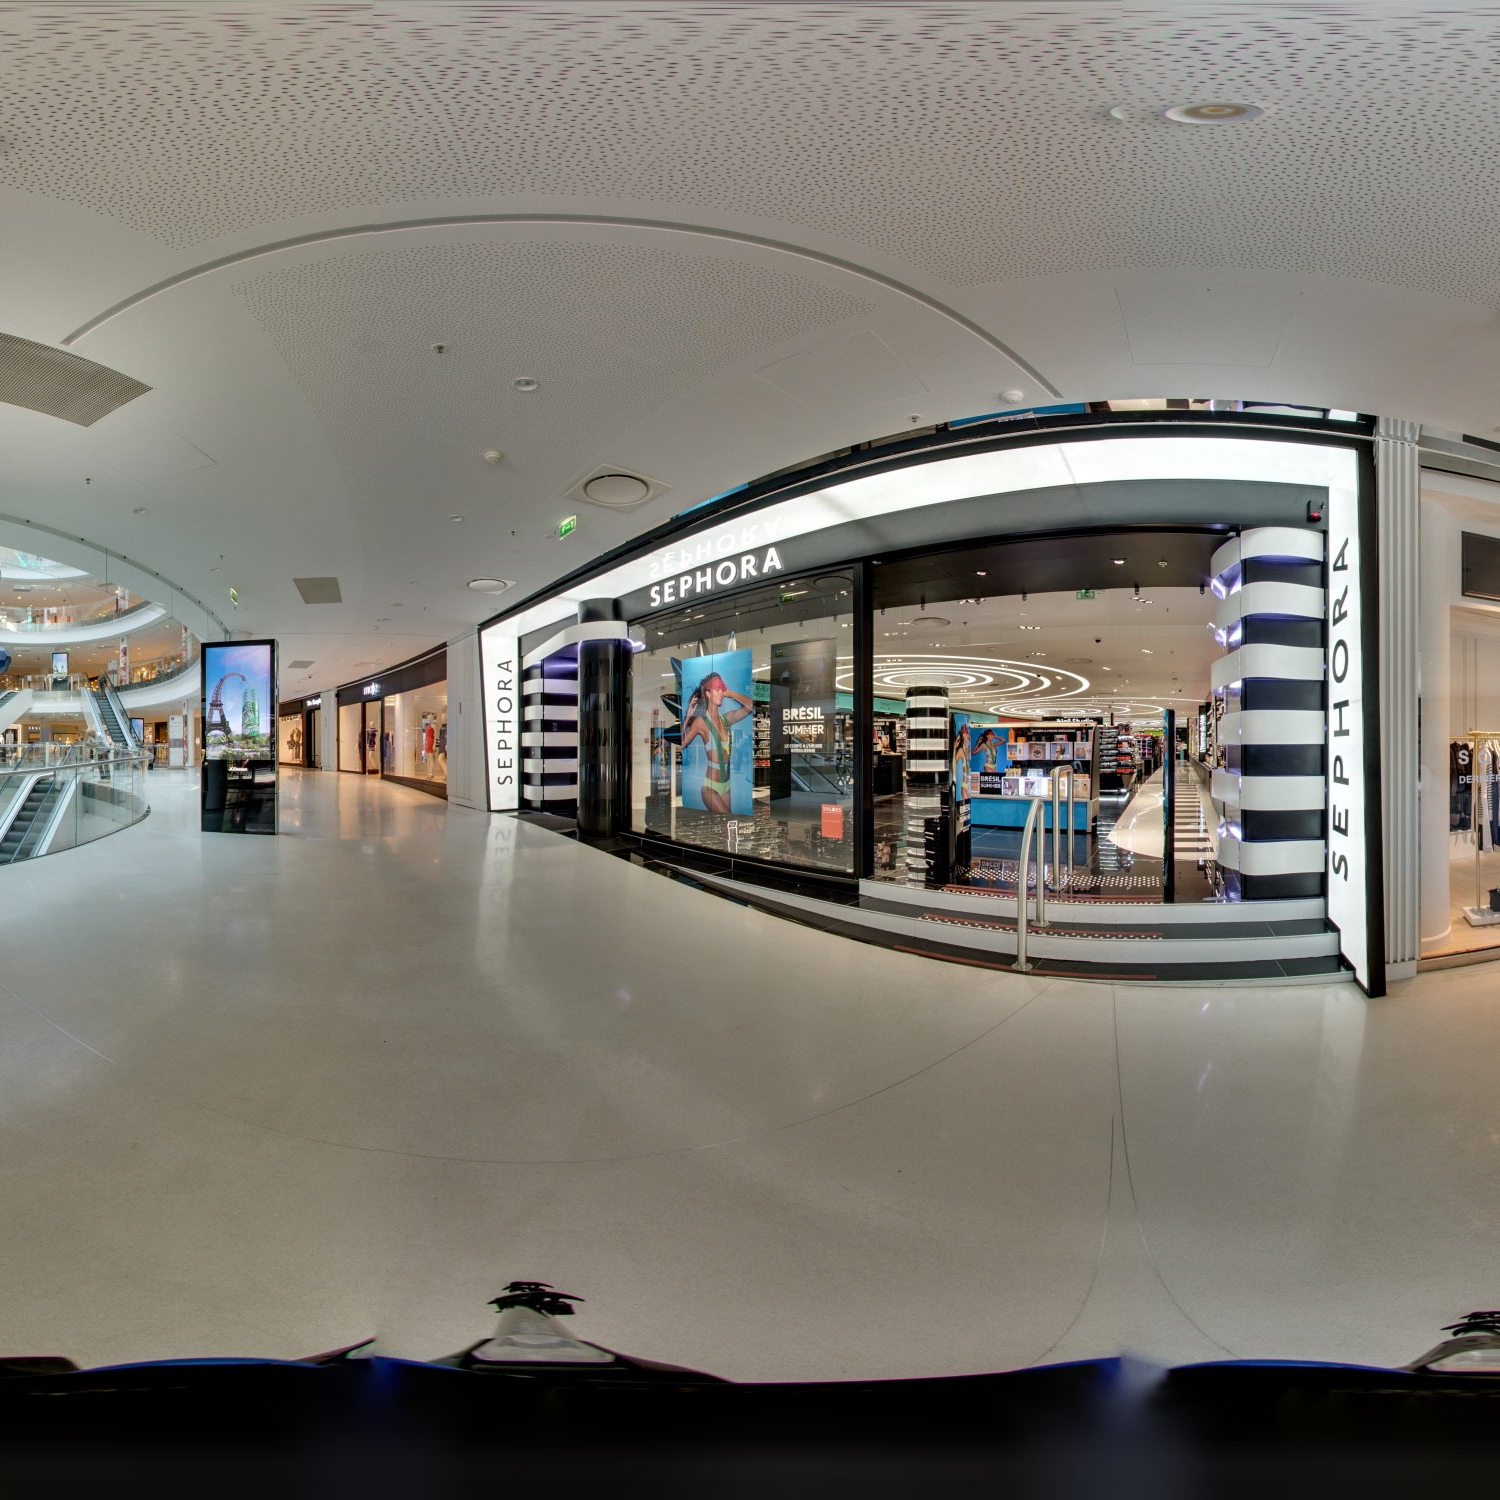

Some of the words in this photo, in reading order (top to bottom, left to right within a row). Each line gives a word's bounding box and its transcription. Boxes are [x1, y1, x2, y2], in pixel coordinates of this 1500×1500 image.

[650, 547, 783, 607] SEPHORA
[496, 659, 512, 785] SEPHORA
[782, 706, 825, 720] BRÉSIL
[782, 725, 825, 734] SUMMER
[1332, 537, 1349, 882] SEPHORA
